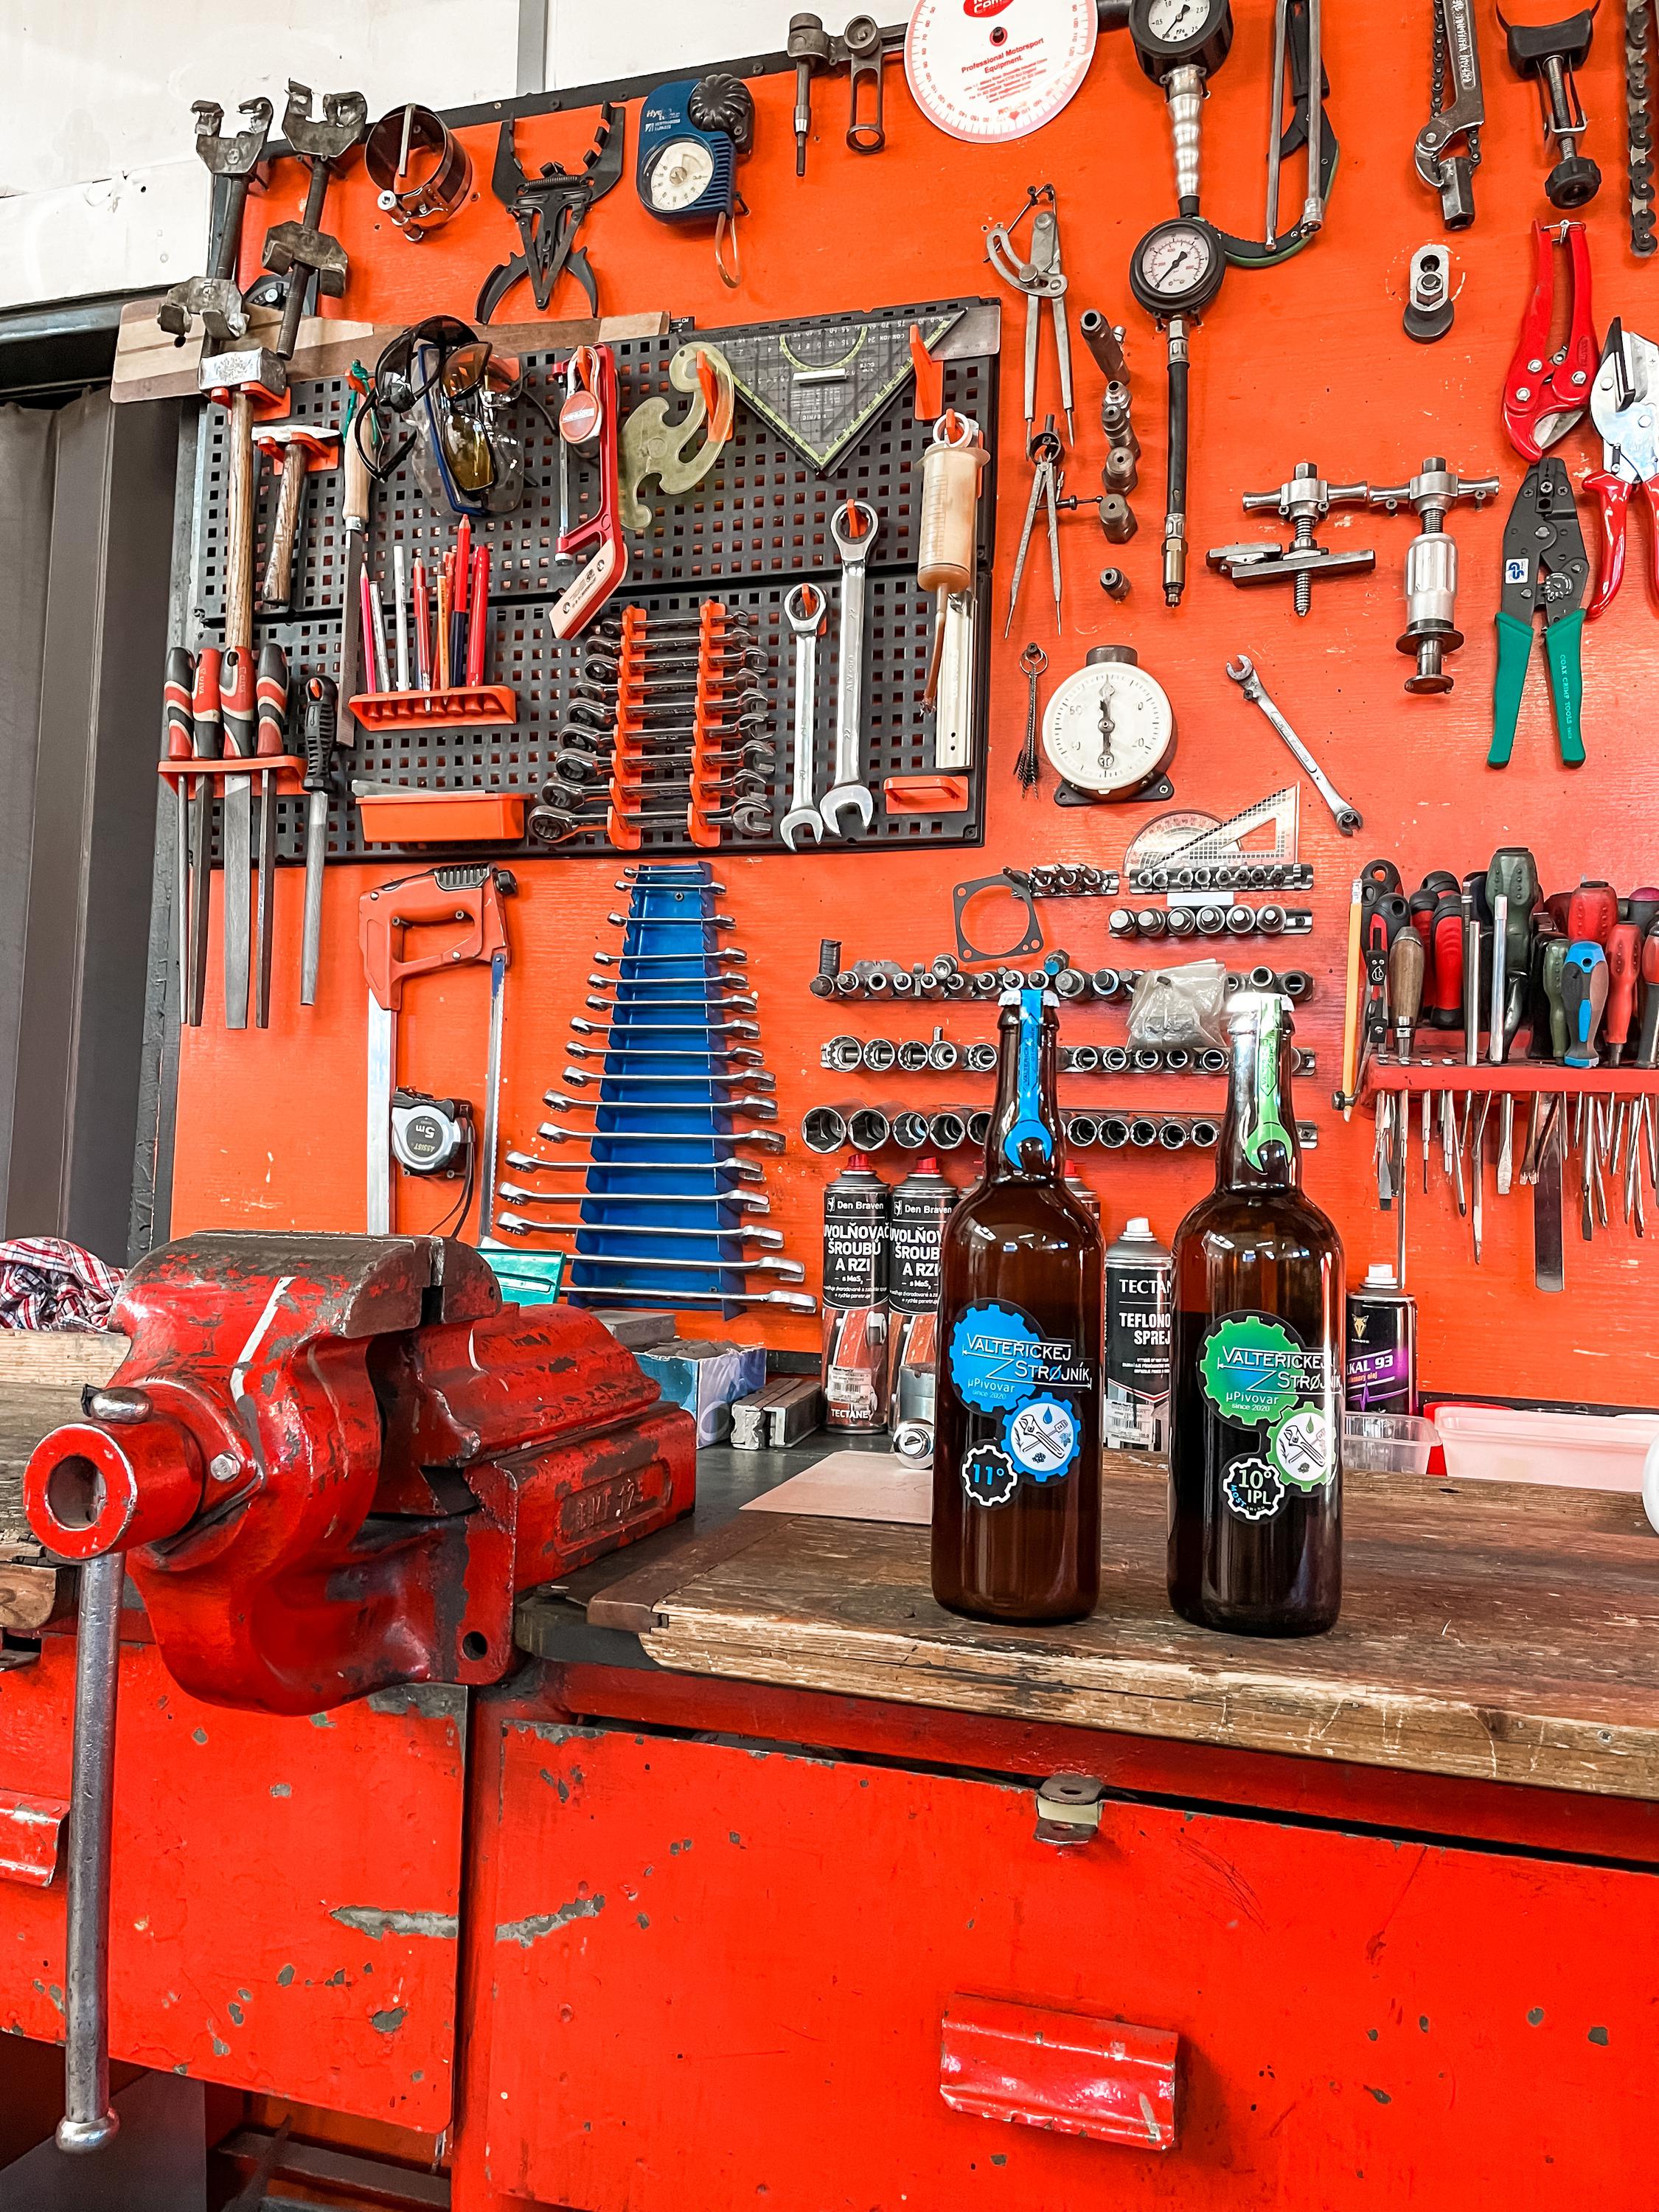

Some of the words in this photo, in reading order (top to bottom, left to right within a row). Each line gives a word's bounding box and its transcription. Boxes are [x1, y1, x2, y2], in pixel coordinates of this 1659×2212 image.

[961, 53, 1004, 74] Professional
[1006, 38, 1044, 57] Motorsport
[415, 1125, 436, 1138] 5m
[414, 1143, 436, 1152] ASSIST
[837, 1200, 854, 1209] Den
[855, 1200, 884, 1210] Braven
[905, 1204, 921, 1214] Den
[924, 1205, 952, 1214] Braven
[828, 1238, 881, 1256] ŠROUBŮ
[835, 1258, 846, 1271] A
[848, 1257, 871, 1272] RZI
[902, 1262, 913, 1276] A
[916, 1262, 939, 1277] RZI
[1134, 1330, 1171, 1345] SPREJ
[1374, 1354, 1394, 1370] 93
[990, 1391, 1006, 1400] 2020
[831, 1409, 871, 1420] TECTANE
[1253, 1404, 1270, 1412] 2020
[1231, 1484, 1247, 1507] MOST
[1248, 1489, 1271, 1505] IPL
